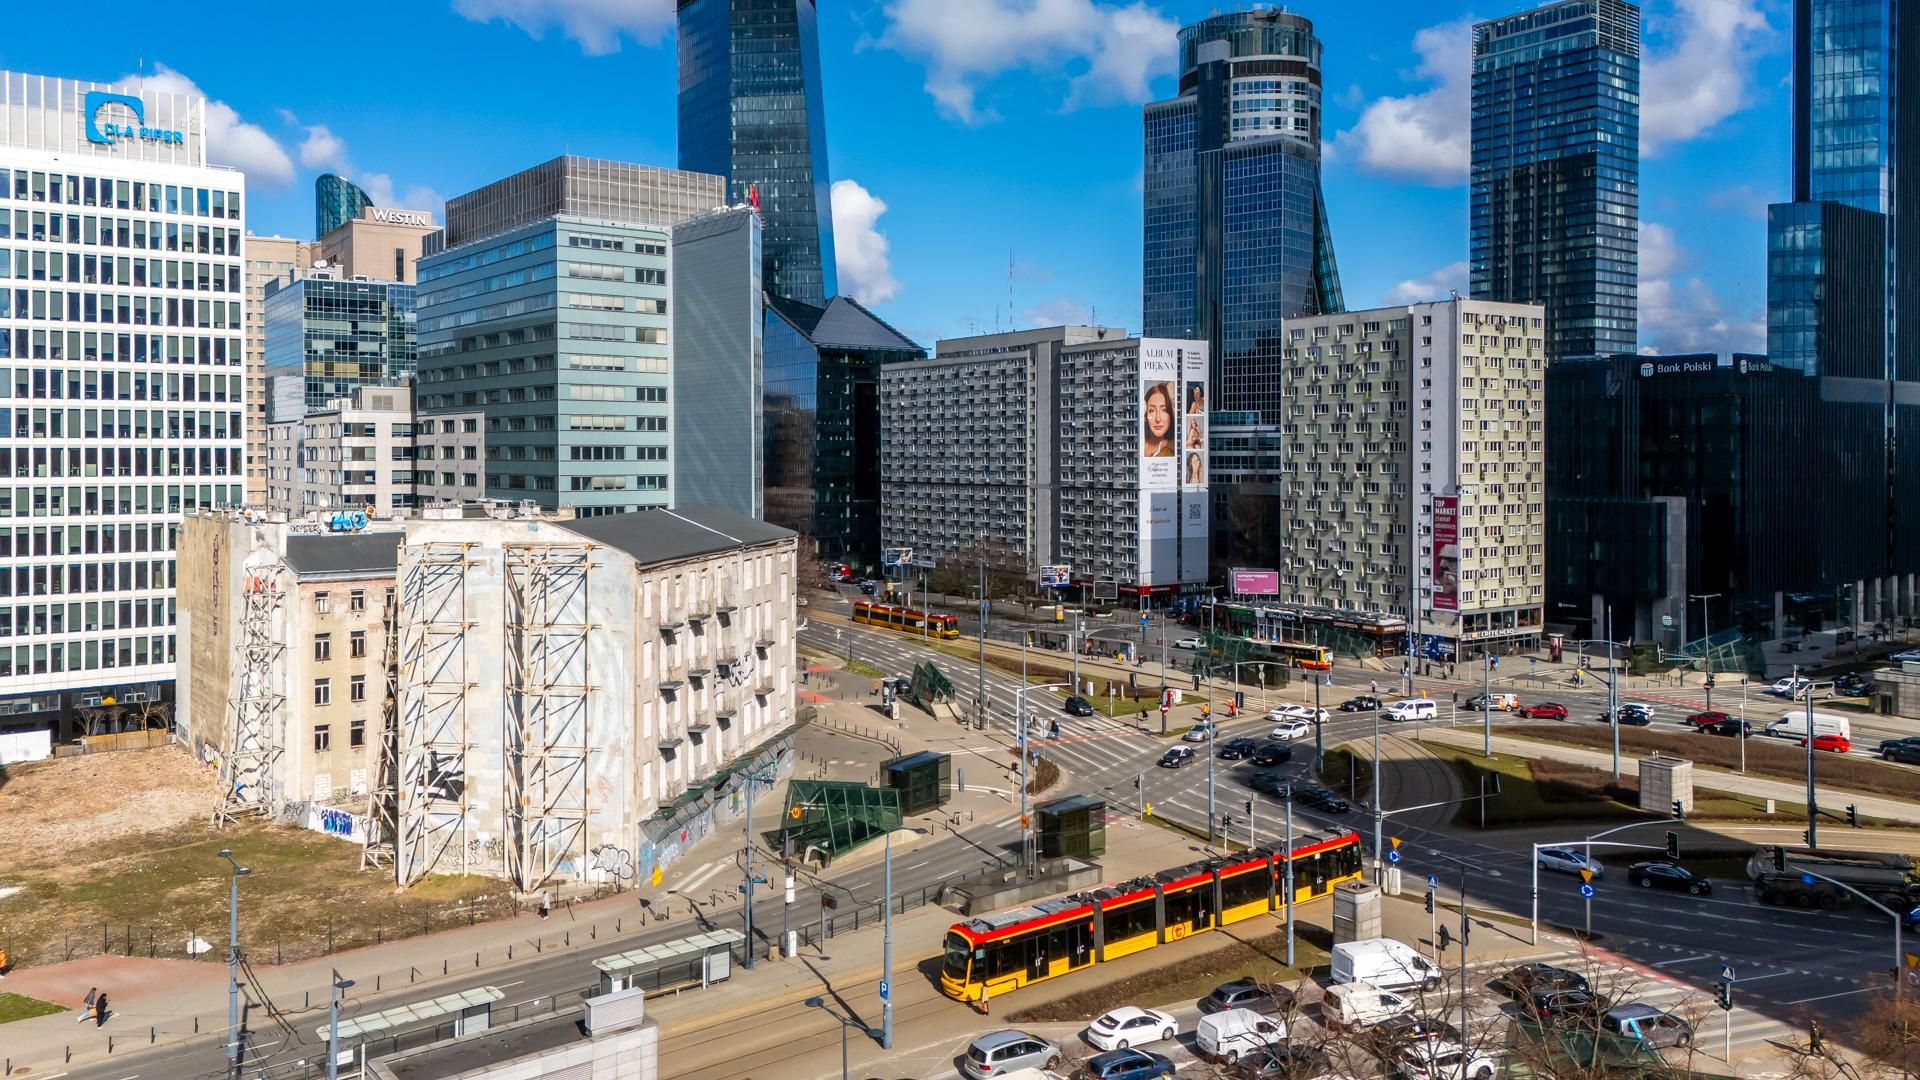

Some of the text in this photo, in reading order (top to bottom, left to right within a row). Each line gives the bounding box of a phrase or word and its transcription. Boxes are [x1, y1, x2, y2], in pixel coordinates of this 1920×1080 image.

[104, 123, 184, 144] DLA PIPER
[1145, 349, 1174, 358] ALBUM
[1144, 361, 1175, 372] PIĘKNA
[1657, 362, 1712, 373] Bank Polski
[1748, 361, 1760, 371] Bank
[1435, 507, 1456, 516] MARKET
[881, 982, 887, 993] P
